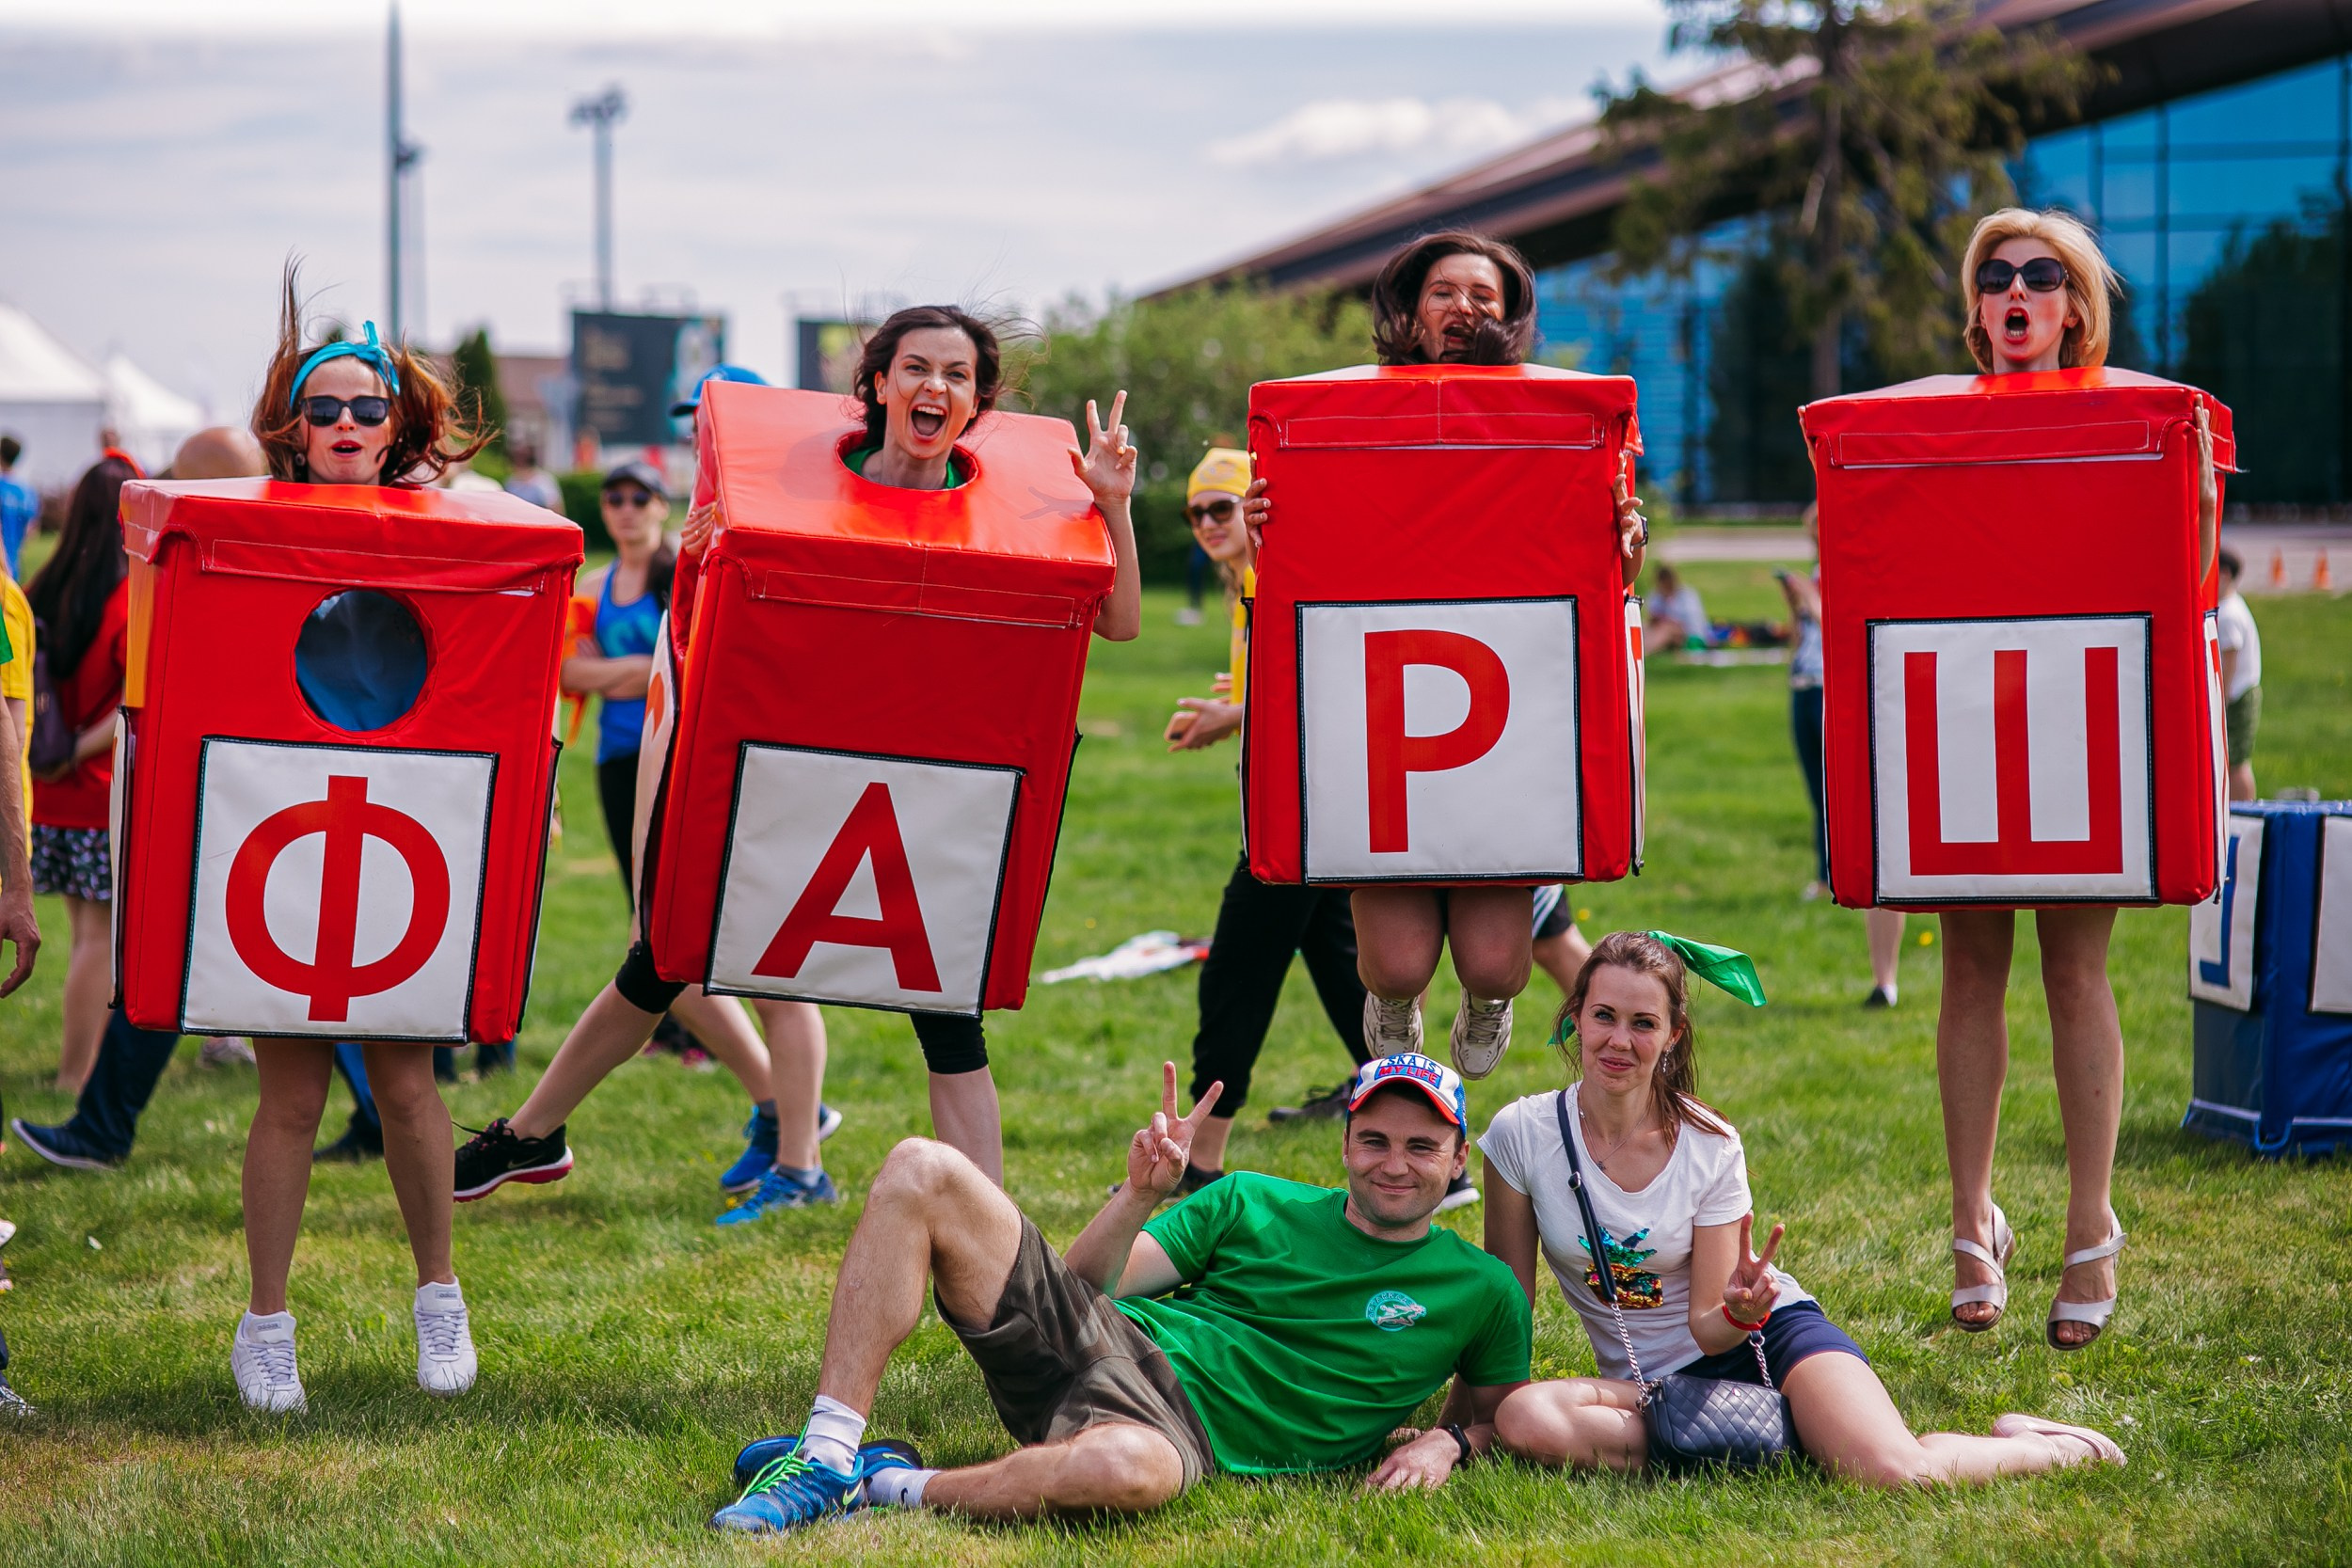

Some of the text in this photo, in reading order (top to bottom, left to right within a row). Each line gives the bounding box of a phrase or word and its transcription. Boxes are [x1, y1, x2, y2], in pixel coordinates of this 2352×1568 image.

[1363, 629, 1510, 854] Р
[1903, 646, 2124, 877] Ш
[225, 774, 451, 1022] Ф
[752, 782, 942, 993] А
[1378, 1066, 1439, 1085] MY LIFE
[1387, 1054, 1437, 1072] SKA IS
